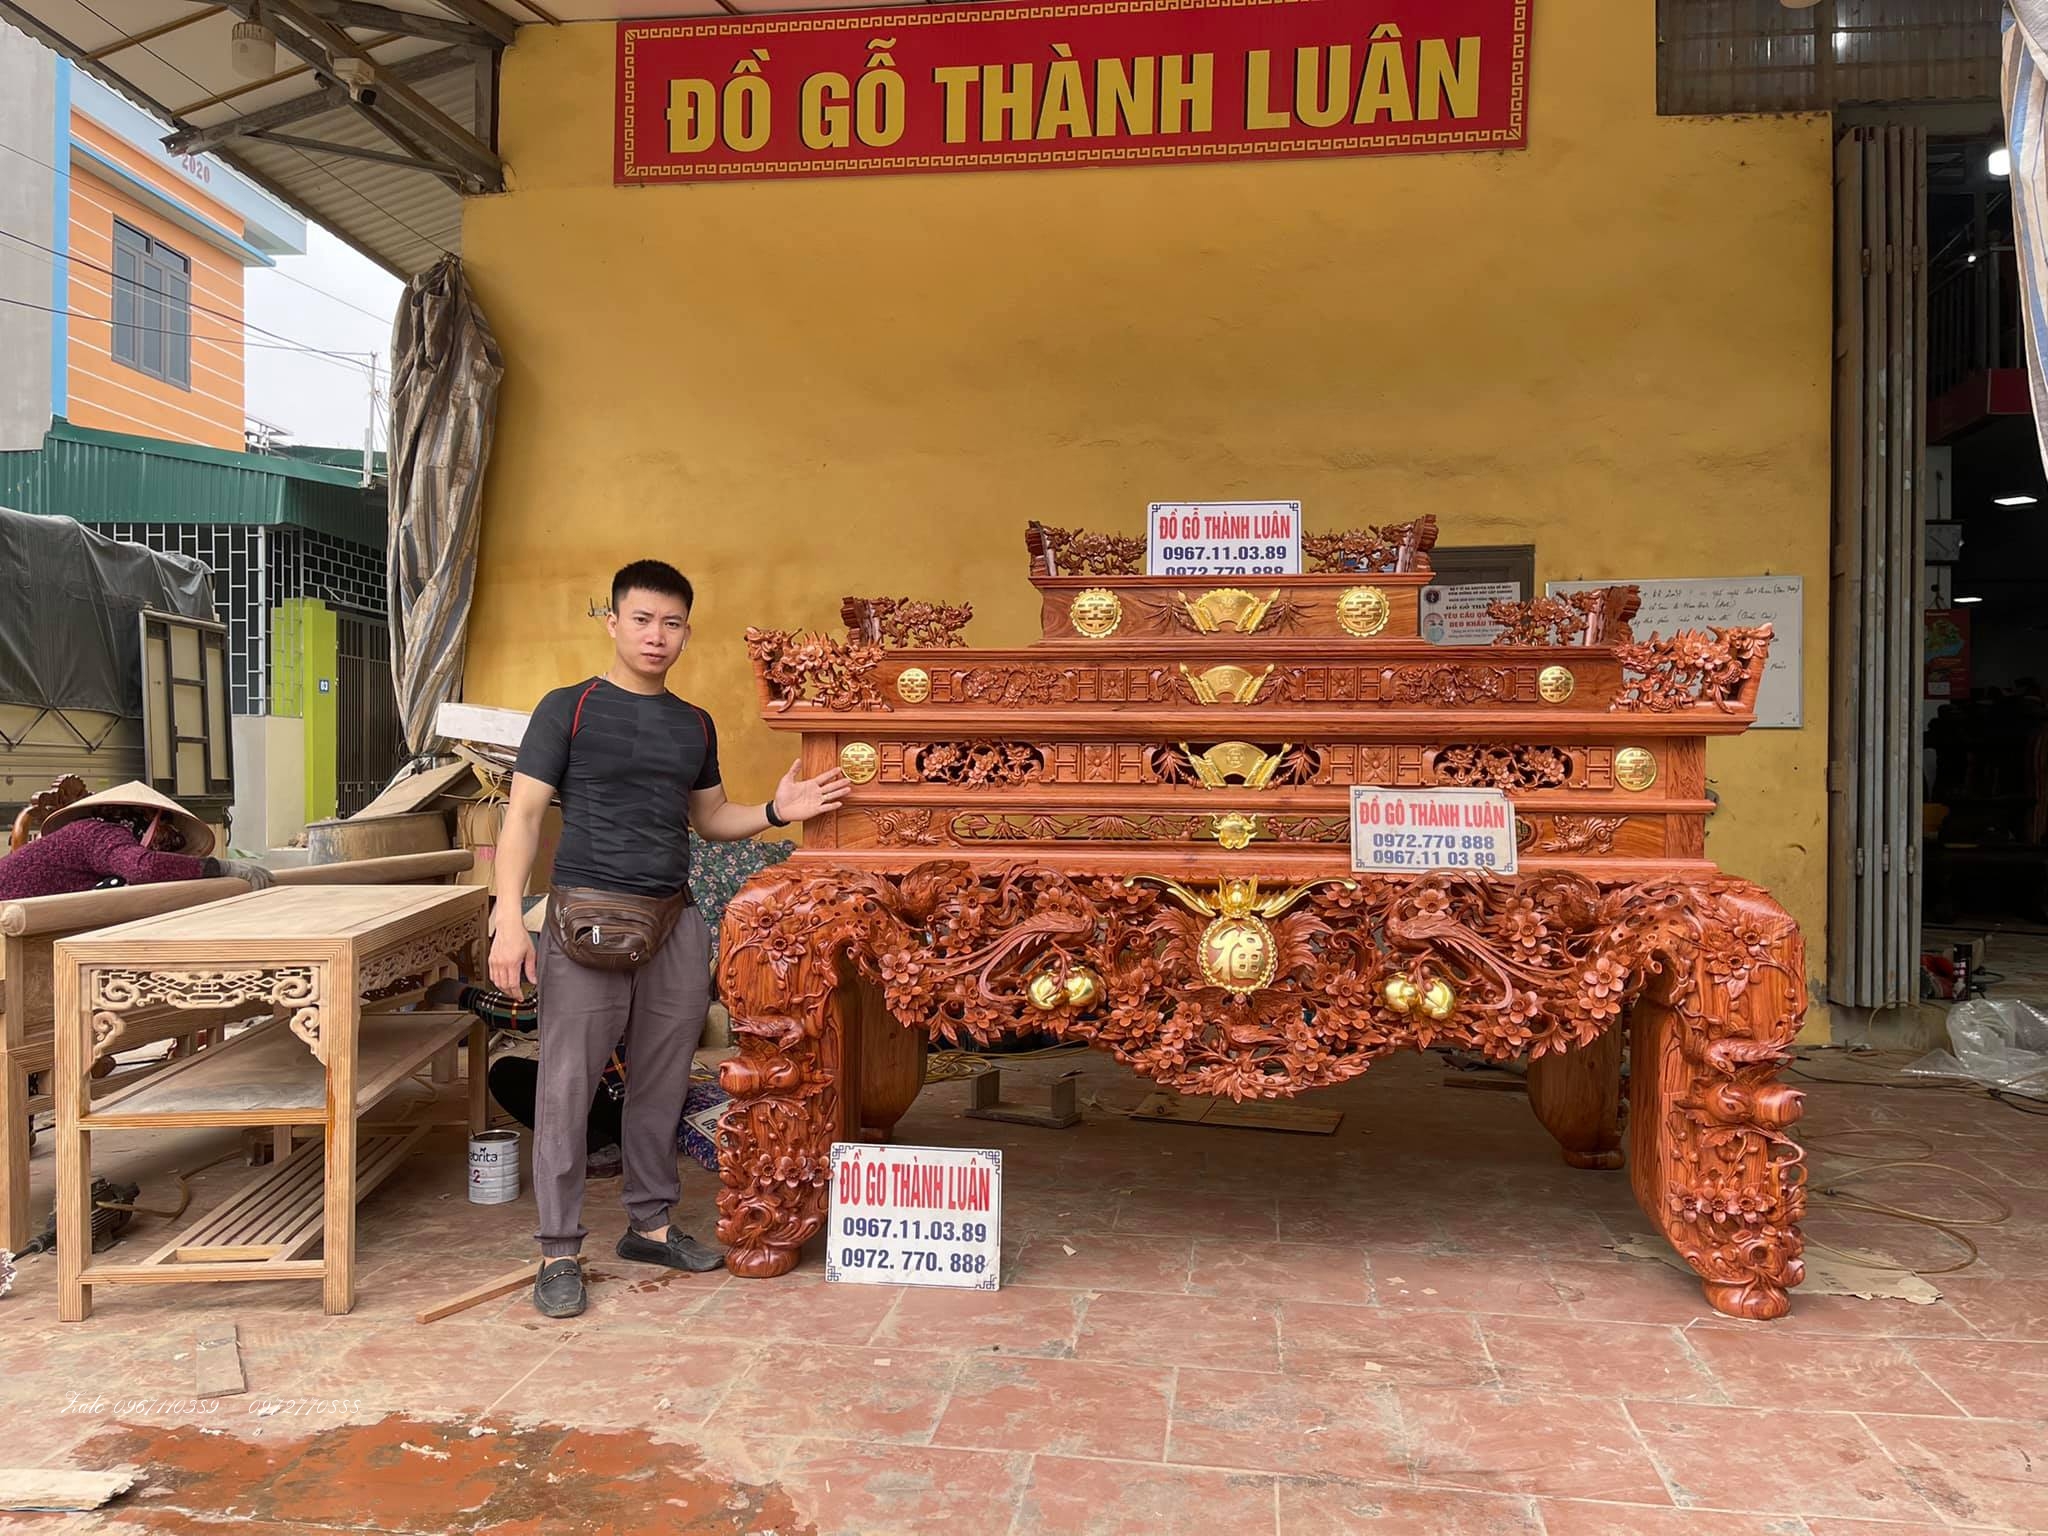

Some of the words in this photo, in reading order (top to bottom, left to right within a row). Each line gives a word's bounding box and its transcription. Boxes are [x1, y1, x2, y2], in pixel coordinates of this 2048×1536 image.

[666, 49, 771, 153] ĐỒ
[802, 37, 905, 150] GỖ
[932, 42, 1214, 144] THÀNH
[1245, 23, 1481, 130] LUÂN
[182, 154, 210, 184] 2020
[1159, 508, 1178, 540] ĐỒ
[1204, 511, 1250, 540] THÀNH
[1254, 510, 1291, 539] LUÂN
[1163, 546, 1287, 561] 0967.11.03.89
[1409, 800, 1460, 828] THÀNH
[1465, 801, 1505, 829] LUÂN
[840, 1149, 862, 1206] ĐỒ
[892, 1156, 944, 1209] THÀNH
[948, 1157, 990, 1212] LUÂN
[843, 1217, 987, 1243] 0967.11.03.89
